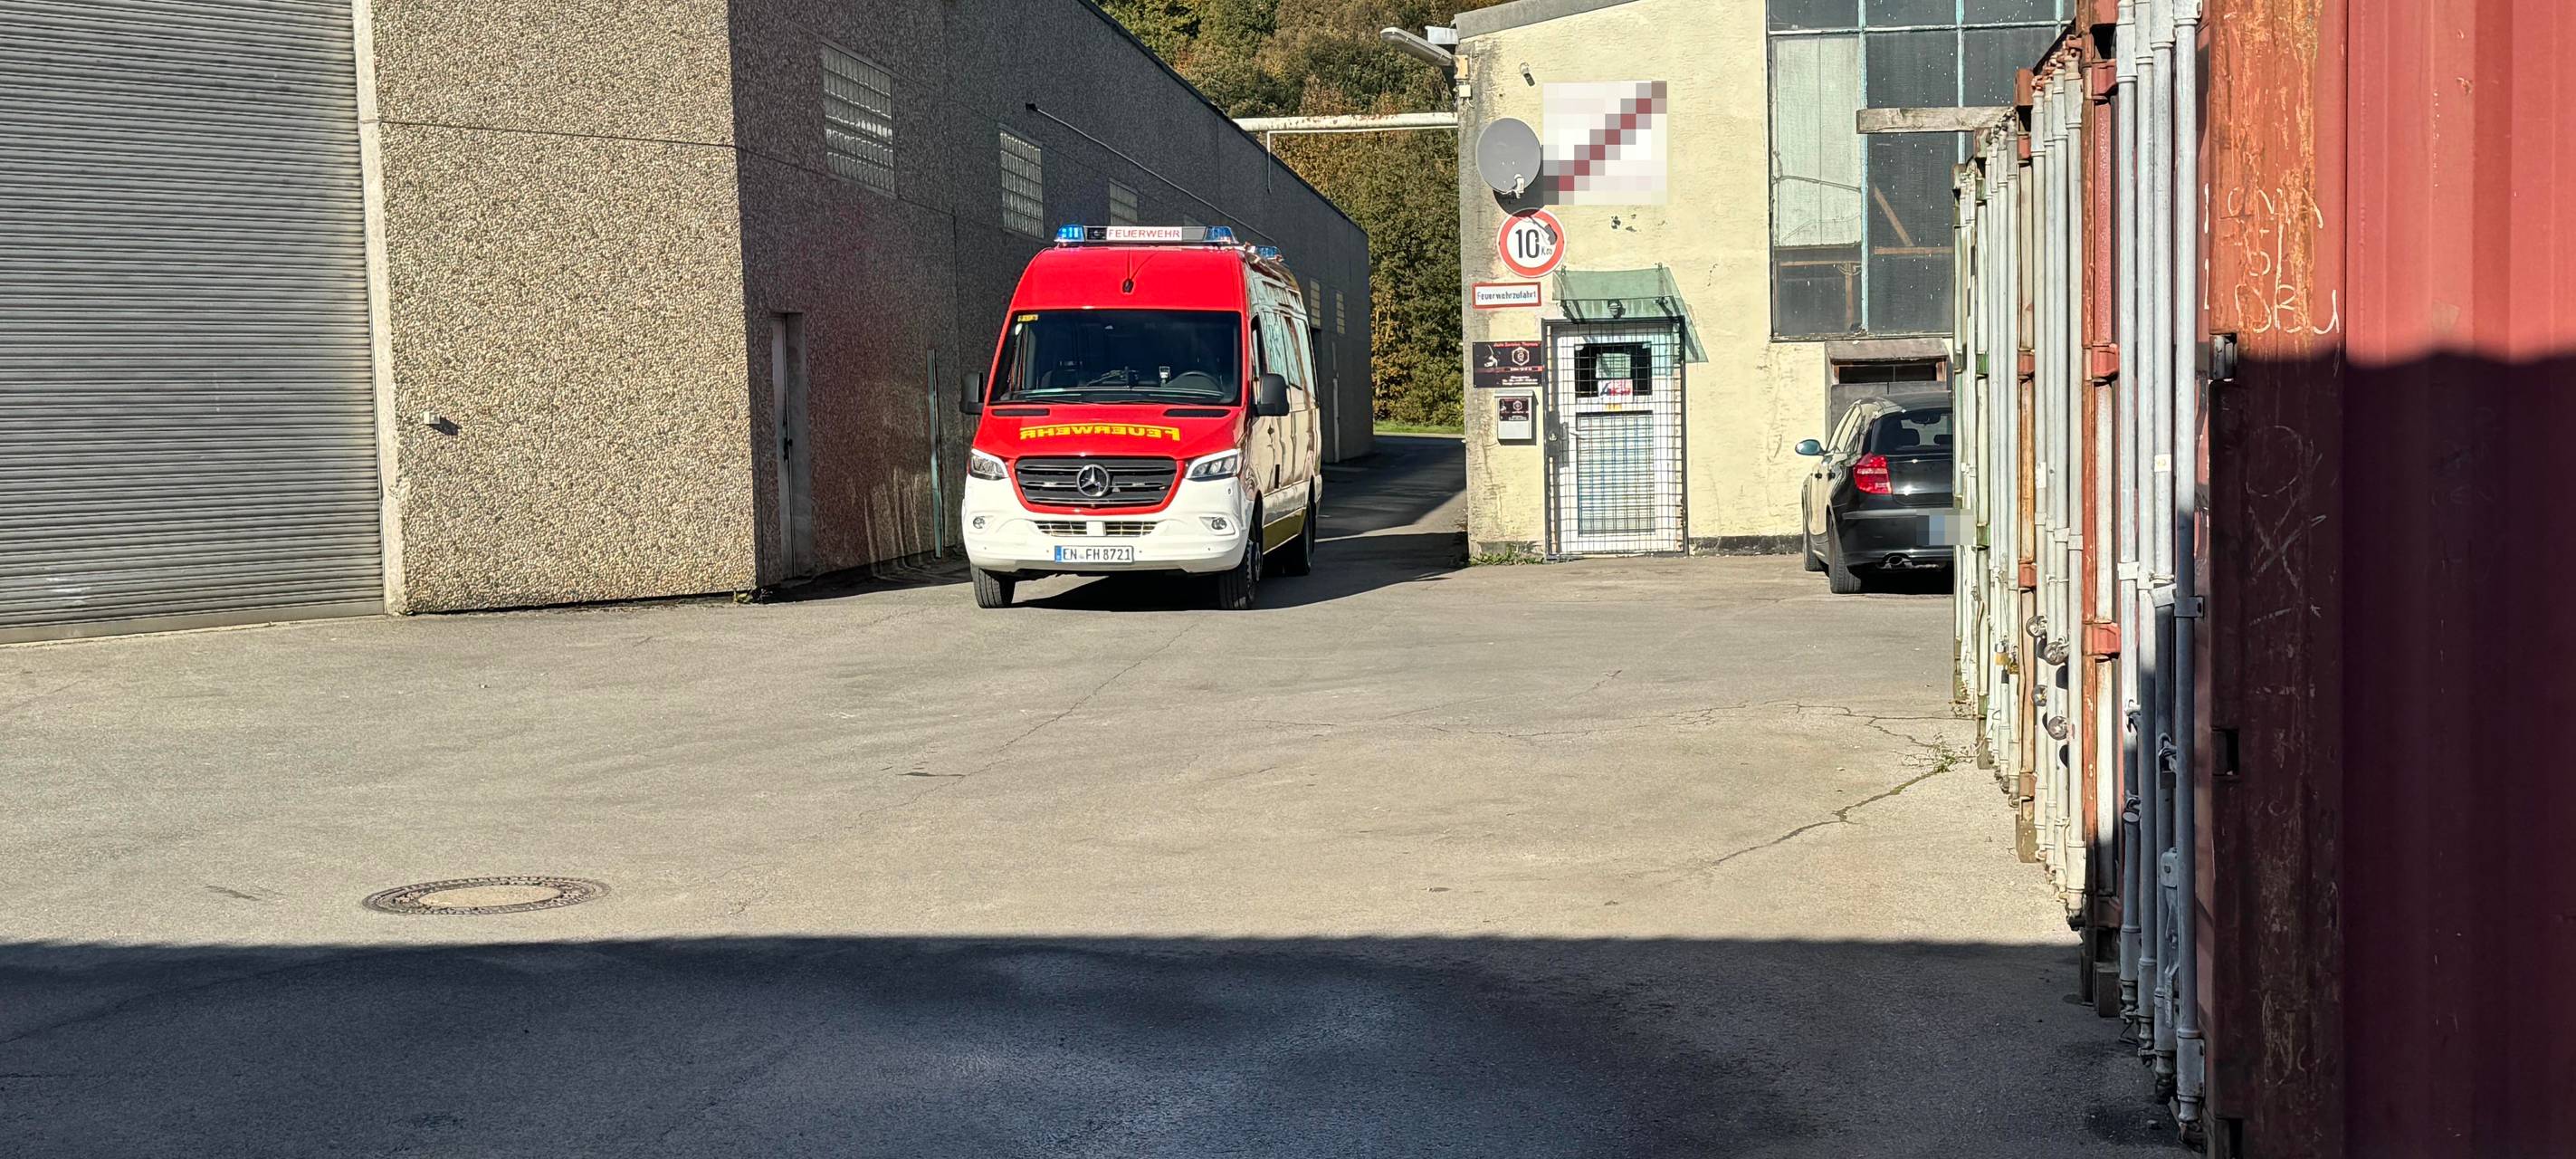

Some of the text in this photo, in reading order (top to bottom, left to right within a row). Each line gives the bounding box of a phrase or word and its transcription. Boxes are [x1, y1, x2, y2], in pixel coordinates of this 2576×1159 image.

[1108, 228, 1180, 239] FEUERWEHR
[1515, 228, 1540, 258] 10
[1476, 290, 1537, 301] Feuerwehrzufahrt
[1063, 548, 1131, 560] EN FH 8721
